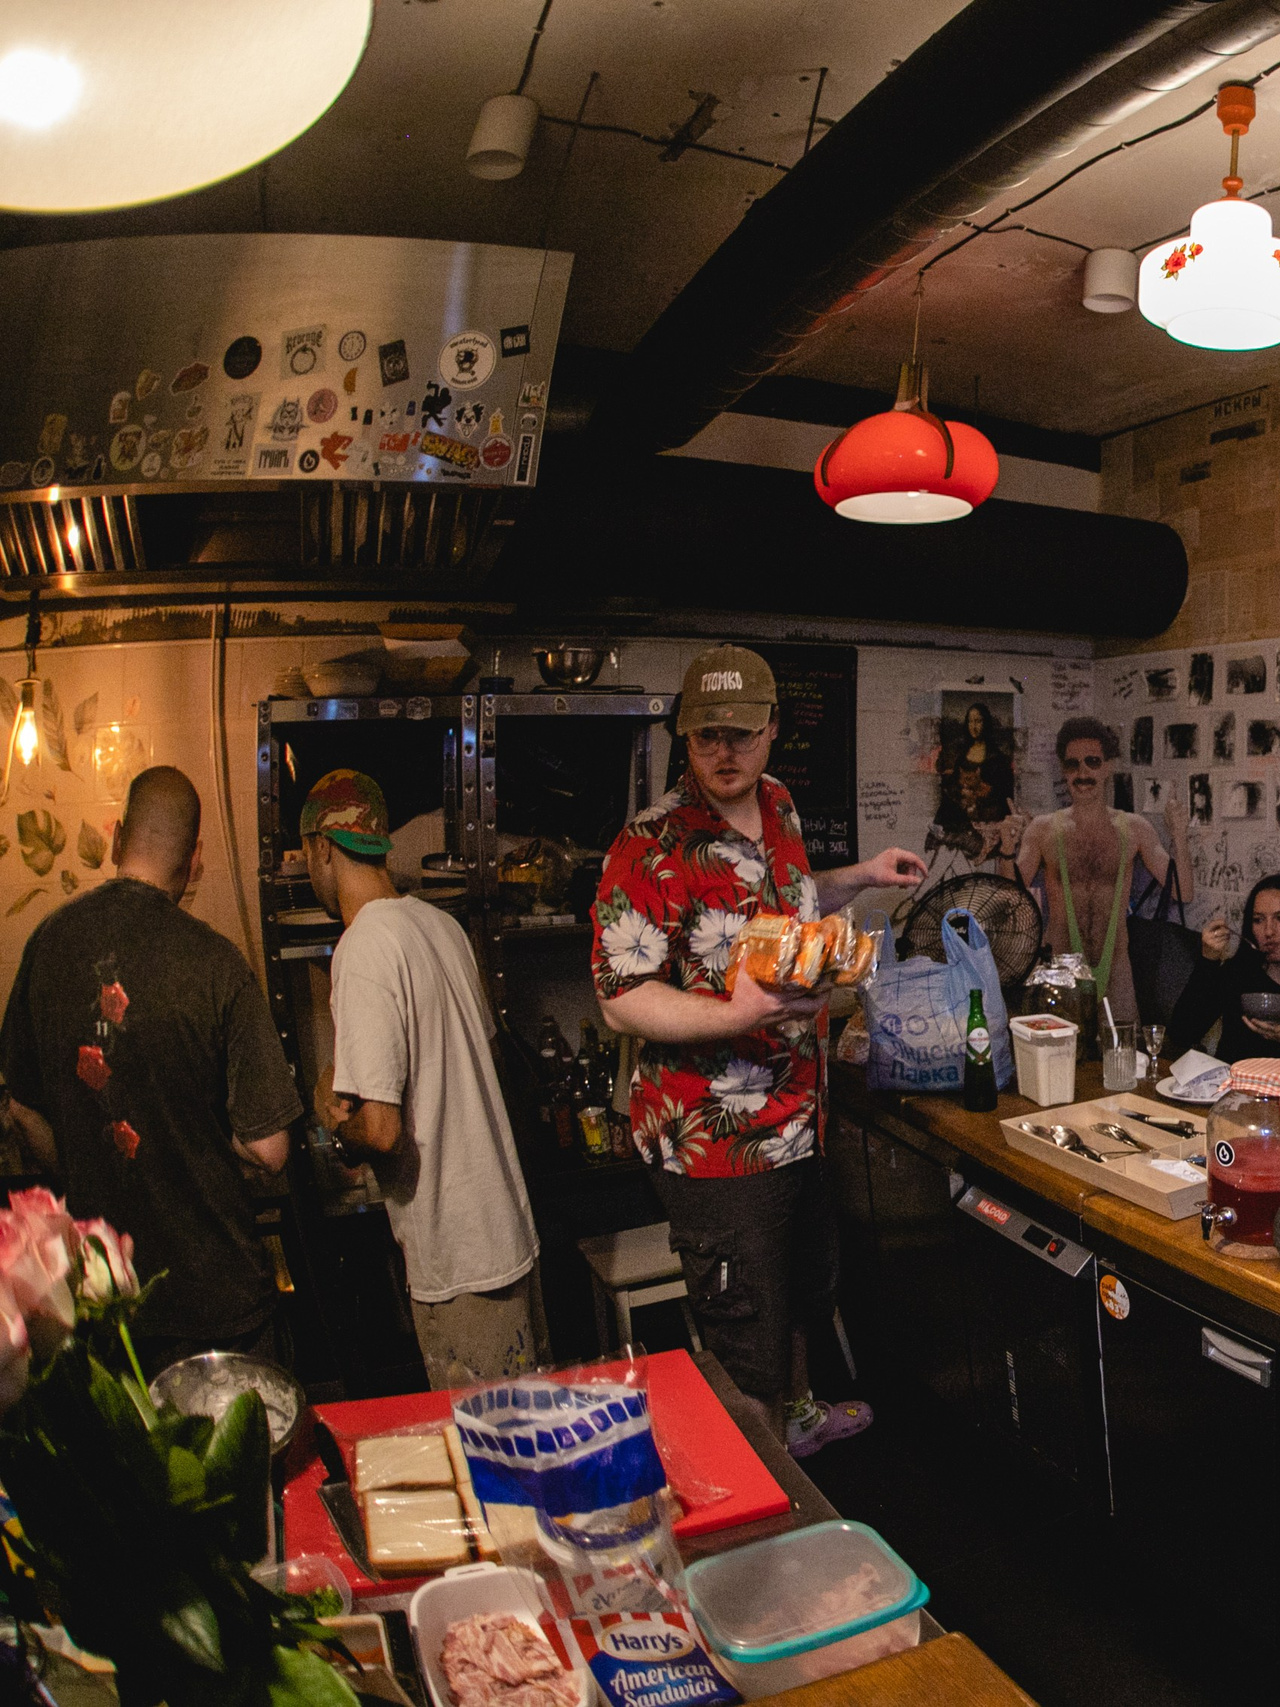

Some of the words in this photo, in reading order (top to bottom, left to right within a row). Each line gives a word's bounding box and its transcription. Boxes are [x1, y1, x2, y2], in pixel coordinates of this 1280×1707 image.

[890, 1059, 960, 1084] Лавка
[610, 1632, 684, 1654] Harry's
[610, 1662, 714, 1696] American
[621, 1678, 718, 1707] Sandwich
